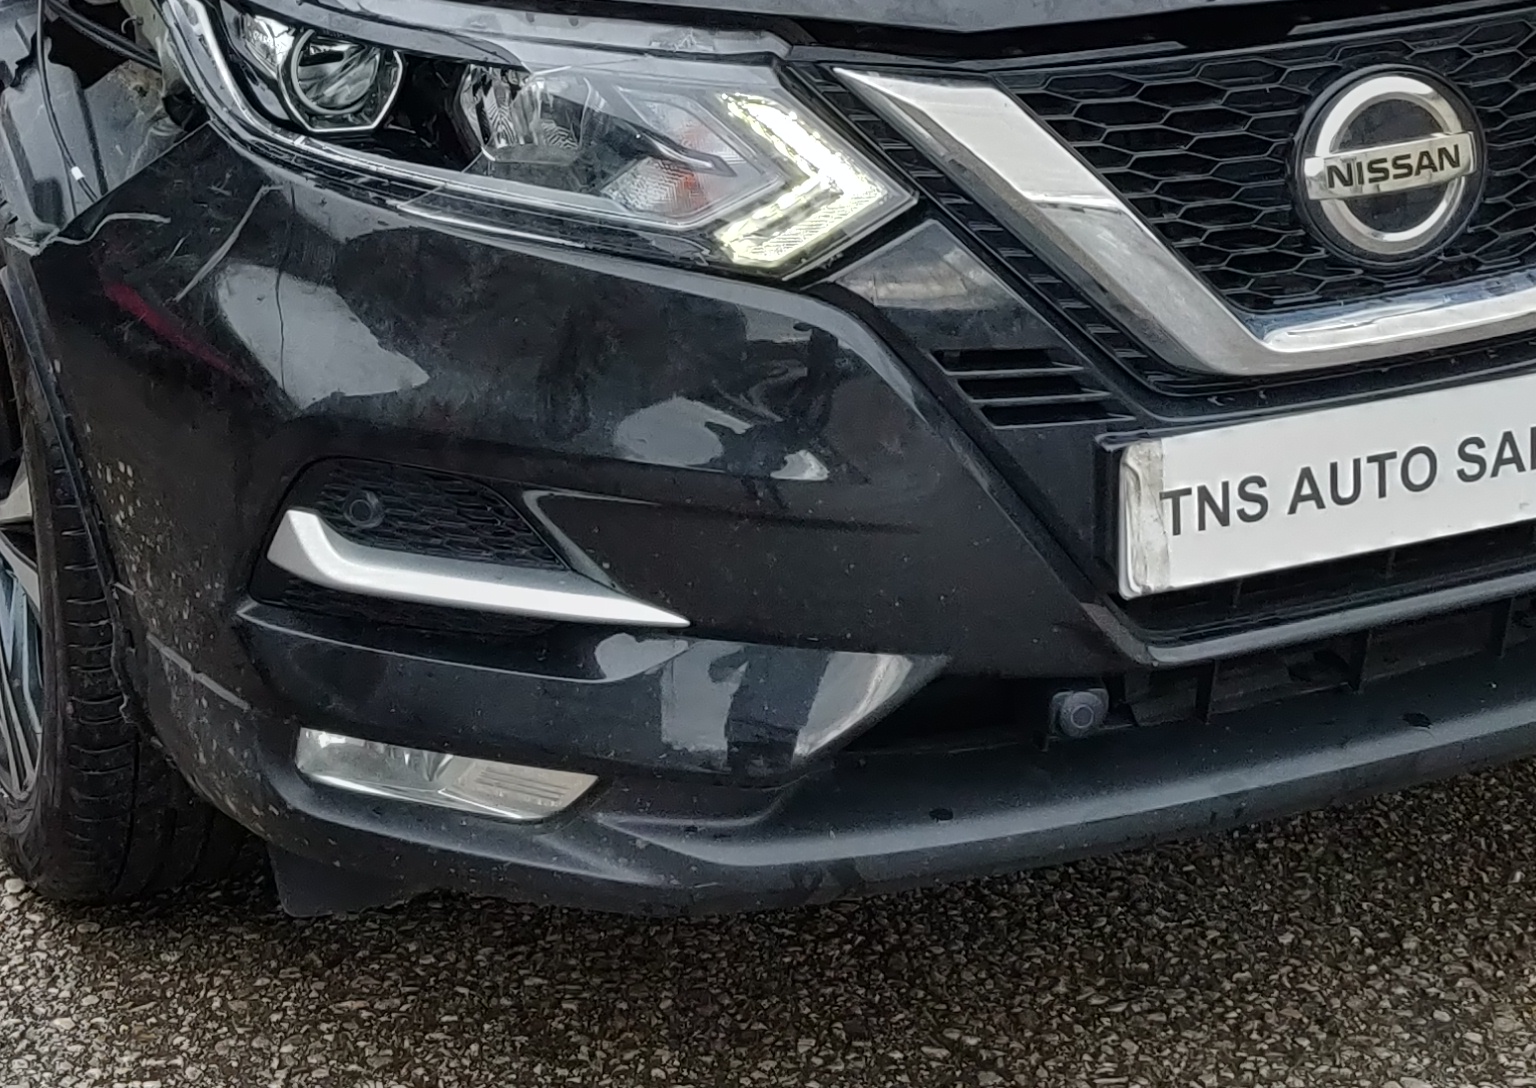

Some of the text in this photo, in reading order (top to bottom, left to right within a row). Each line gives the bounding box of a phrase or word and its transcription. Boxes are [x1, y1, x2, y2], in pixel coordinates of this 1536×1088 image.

[1325, 143, 1462, 190] NISSAN
[1159, 474, 1270, 537] TNS
[1286, 445, 1439, 515] AUTO
